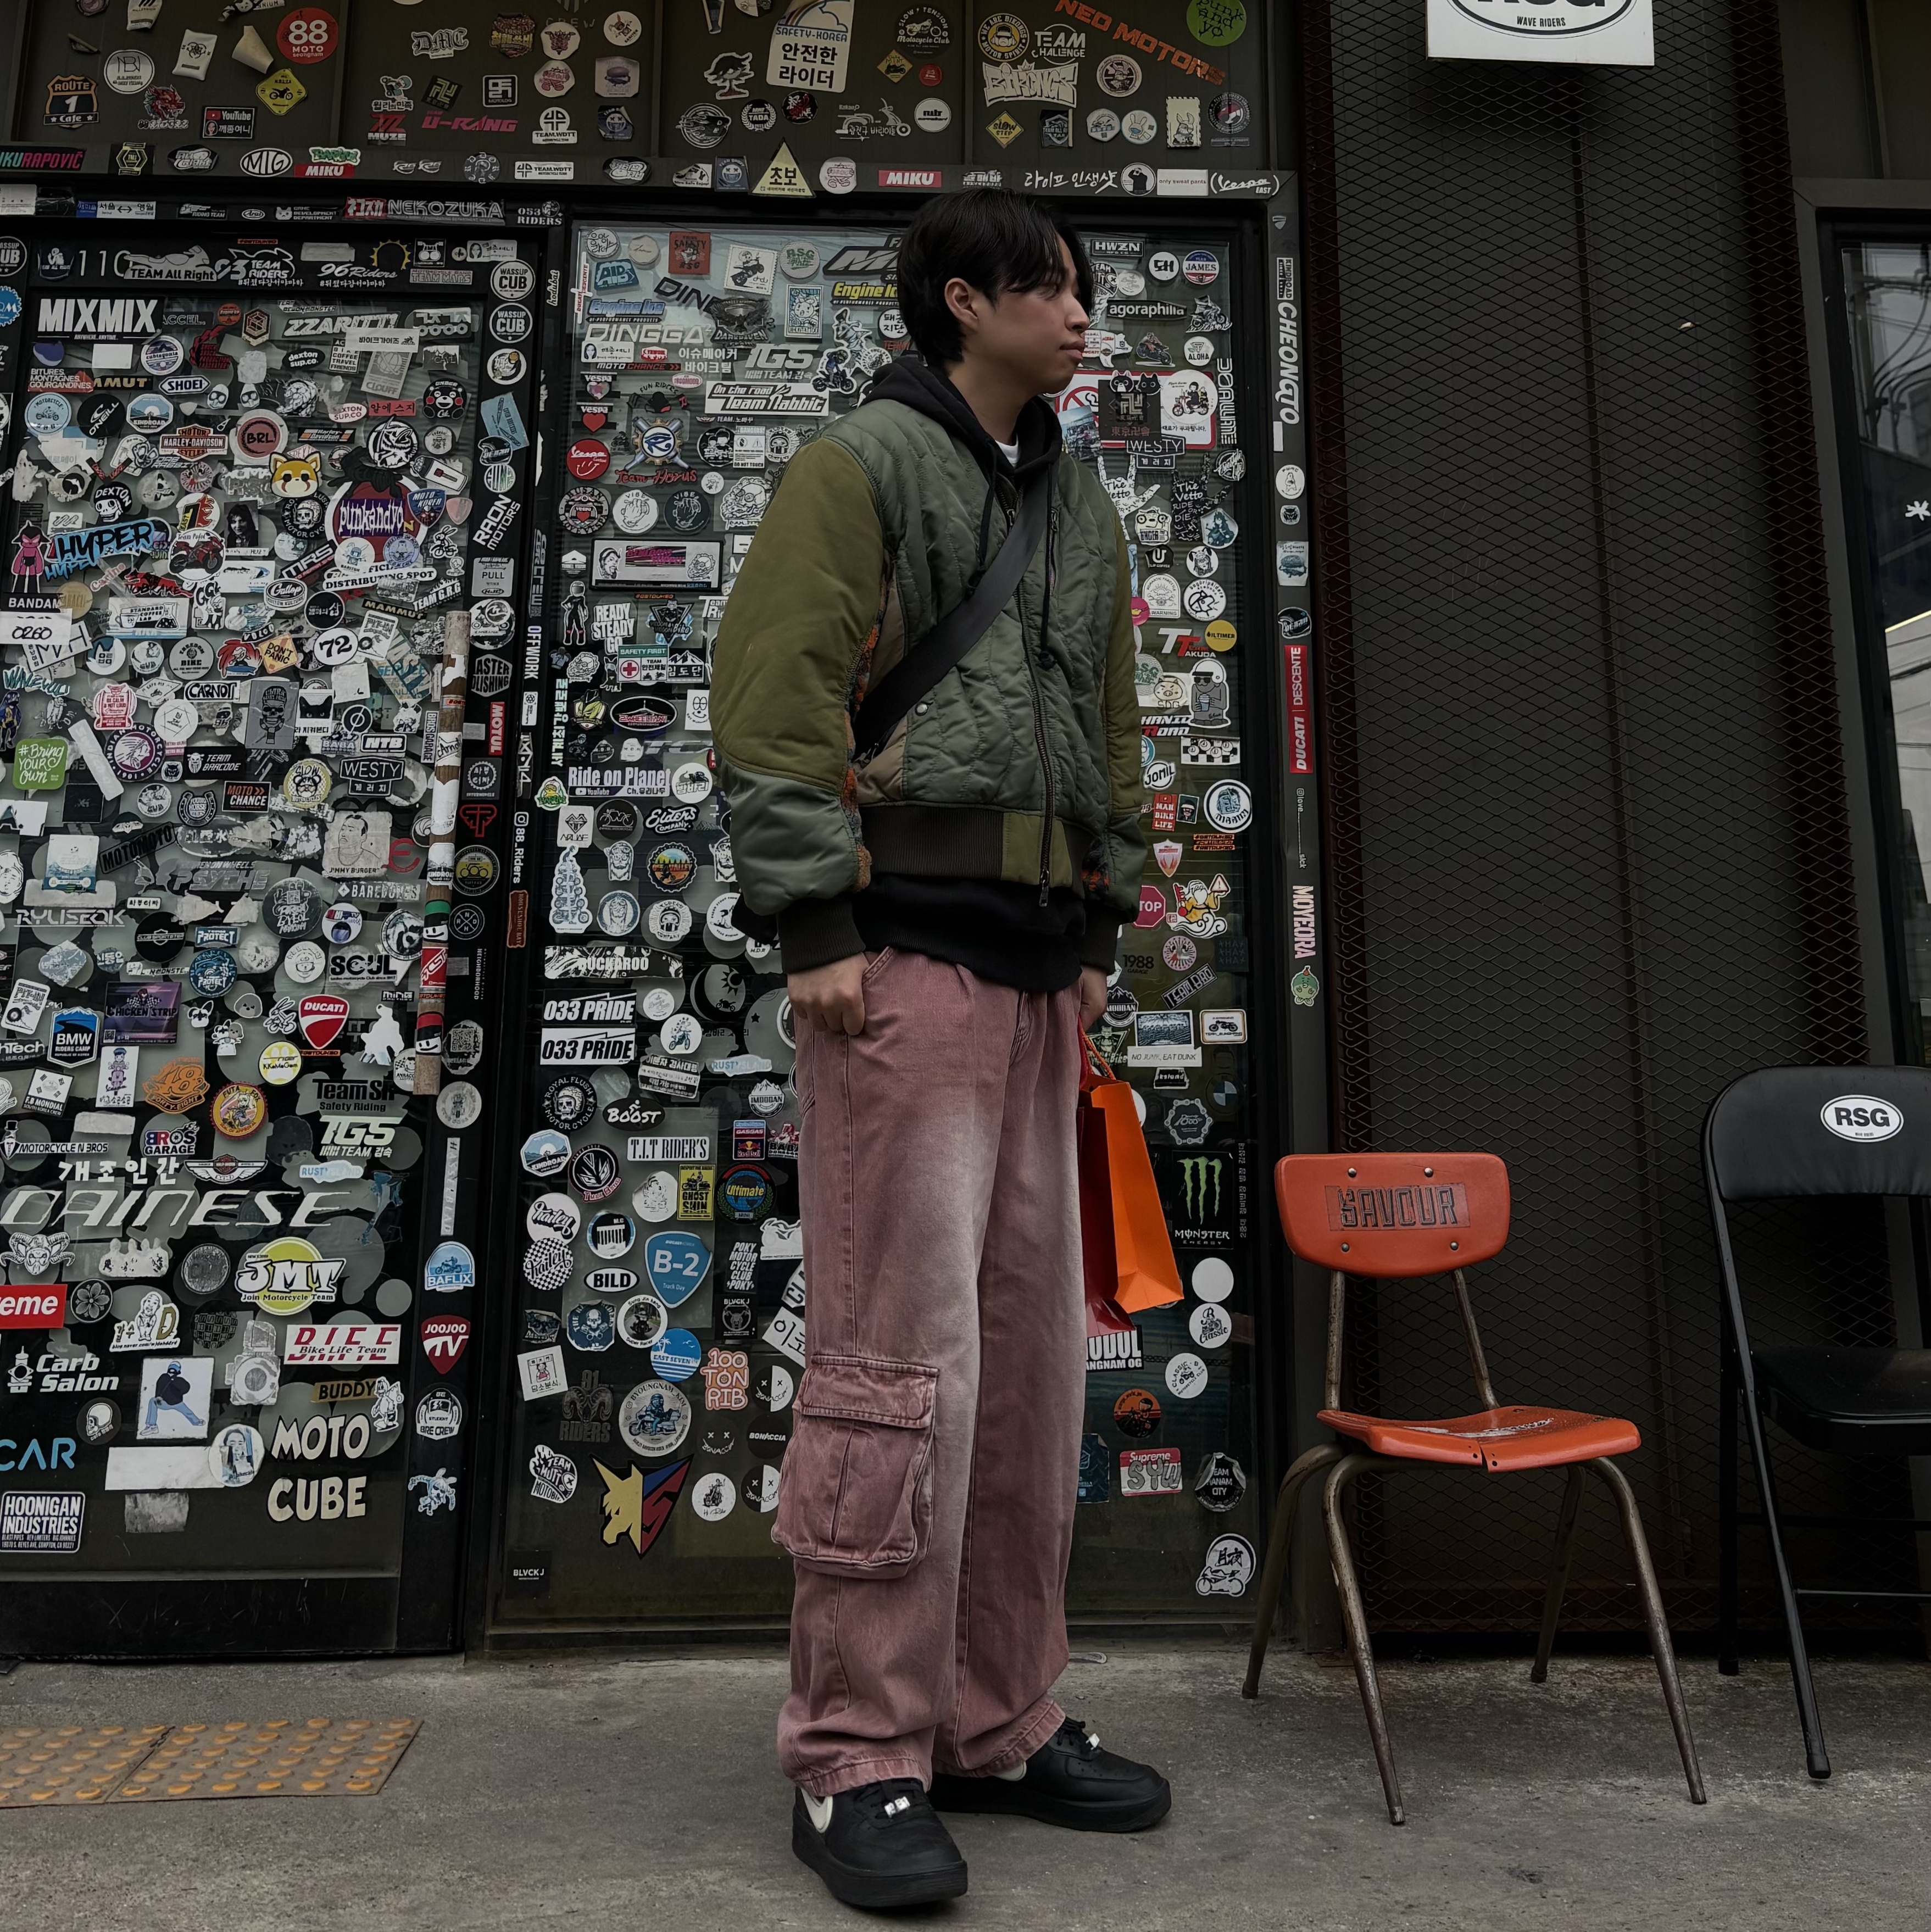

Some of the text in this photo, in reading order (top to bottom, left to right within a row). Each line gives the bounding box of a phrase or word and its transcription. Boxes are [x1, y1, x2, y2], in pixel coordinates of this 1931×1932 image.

[1517, 16, 1566, 27] WAVE RIDERS
[288, 20, 329, 44] 88
[776, 26, 848, 42] SAFETY-KOREA
[1034, 30, 1086, 48] TEAM
[1055, 0, 1226, 86] NEO MOTORS
[782, 42, 838, 64] 안전한
[1031, 48, 1085, 58] CHALLENGE
[778, 66, 835, 89] 라이더
[54, 82, 90, 91] ROUTE
[64, 96, 78, 113] 1
[59, 113, 82, 123] Cafe
[222, 111, 252, 121] YouTube
[368, 132, 407, 141] MUZE
[305, 165, 344, 176] MIKU
[770, 166, 798, 186] 초보
[886, 172, 934, 185] MIKU
[1024, 170, 1117, 194] 라이프 인생샷
[388, 200, 504, 219] NEKOZUKA
[518, 207, 541, 216] 053
[517, 216, 562, 225] RIDERS
[1095, 243, 1140, 252] HWZN
[131, 268, 214, 281] TEAM All Right
[317, 264, 398, 279] 96 Riders
[498, 277, 526, 289] CUB
[589, 300, 665, 315] Engine Ice
[1109, 303, 1184, 318] agoraphilia
[496, 319, 525, 331] CUB
[359, 336, 399, 344] 바이크가이즈
[678, 348, 737, 360] 이슈메이커
[685, 361, 732, 372] 바이크팀
[168, 379, 203, 391] SHOEI
[714, 384, 772, 395] On the road
[726, 394, 823, 411] Team Rabbit
[1130, 440, 1181, 452] WESTY
[474, 495, 511, 545] RAON
[487, 502, 521, 550] MOTORS
[58, 522, 152, 562] HYPER
[365, 602, 426, 619] MAMMUT
[597, 604, 631, 621] READY
[593, 620, 634, 639] STEADY
[268, 642, 293, 655] DON'T
[320, 636, 352, 656] 72
[524, 626, 541, 680] OFWORK
[265, 650, 290, 664] PANIC
[668, 666, 703, 677] 임도단
[1291, 647, 1301, 705] DESCENTE
[490, 704, 503, 755] MOTUL
[19, 756, 47, 771] YOUR
[344, 761, 399, 778] WESTY
[19, 771, 47, 784] Own
[569, 767, 671, 786] Ride on Planet
[227, 786, 253, 795] MOTO
[230, 795, 267, 805] CHANCE
[331, 955, 397, 976] SOUL
[1123, 954, 1154, 968] 1988
[304, 1003, 344, 1012] DUCATI
[544, 1000, 635, 1021] 033 PRIDE
[56, 1033, 92, 1045] BMW
[542, 1039, 633, 1059] 033 PRIDE
[320, 1101, 386, 1112] Safety Riding
[608, 1109, 661, 1123] BOOST
[1835, 1107, 1889, 1127] RSG
[19, 1144, 76, 1152] MOTORCYCLE
[77, 1144, 85, 1152] N
[145, 1145, 194, 1154] GARAGE
[341, 1146, 371, 1157] TEAM
[58, 1157, 180, 1185] 개조인간
[727, 1186, 764, 1196] Ultimate
[1175, 1229, 1229, 1239] MONSTER
[654, 1253, 699, 1277] B-2
[237, 1260, 344, 1293] JMT
[428, 1274, 471, 1286] BAFLIX
[593, 1273, 631, 1287] BILD
[425, 1324, 466, 1334] JOOJOO
[36, 1355, 99, 1372] Carb
[708, 1350, 746, 1367] 100
[40, 1375, 119, 1392] Salon
[701, 1368, 749, 1387] TON
[319, 1382, 374, 1400] BUDDY
[708, 1390, 747, 1409] RIB
[271, 1415, 370, 1460] MOTO
[1129, 1451, 1170, 1462] Supreme
[5, 1496, 81, 1516] HOONIGAN
[268, 1476, 366, 1521] CUBE
[2, 1518, 78, 1534] INDUSTRIES
